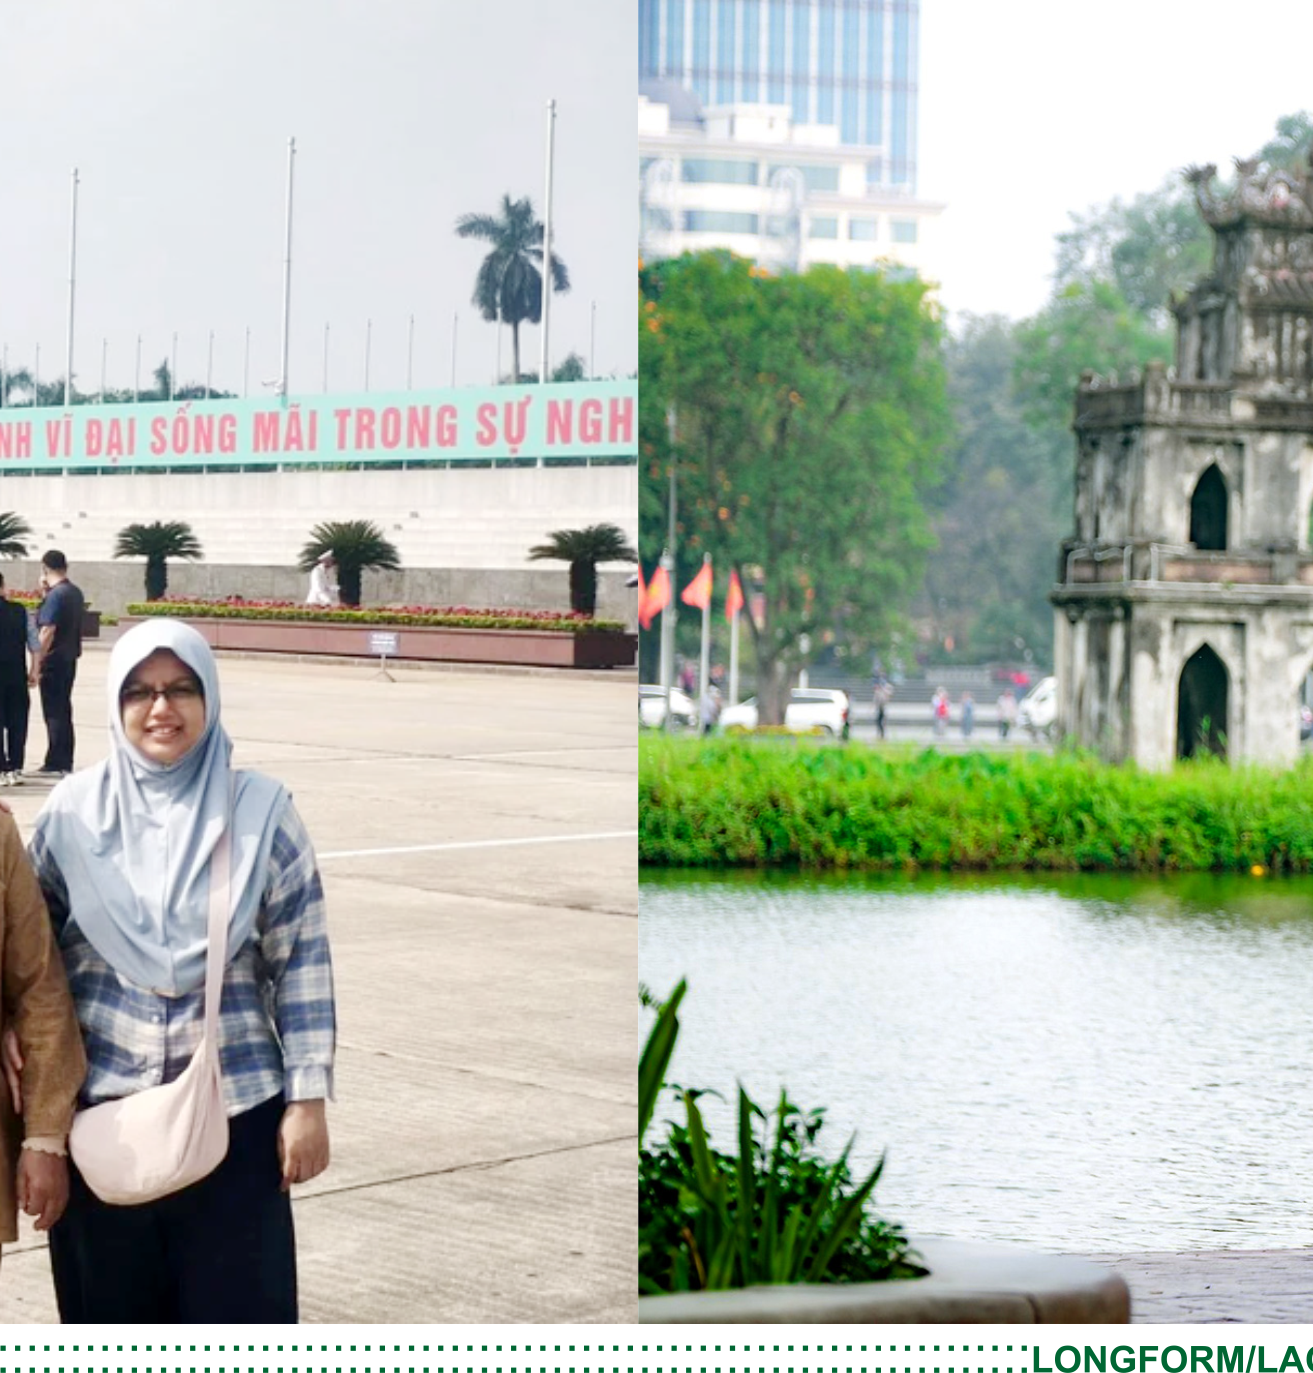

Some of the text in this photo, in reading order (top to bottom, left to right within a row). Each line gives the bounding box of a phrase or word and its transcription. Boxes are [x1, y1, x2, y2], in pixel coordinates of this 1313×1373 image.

[45, 413, 72, 458] VĨ
[85, 417, 136, 463] ĐẠI
[150, 402, 238, 455] SỐNG
[252, 402, 318, 452] MÃI
[334, 404, 458, 450] TRONG
[475, 394, 532, 454] SỰ
[546, 396, 634, 446] NGH
